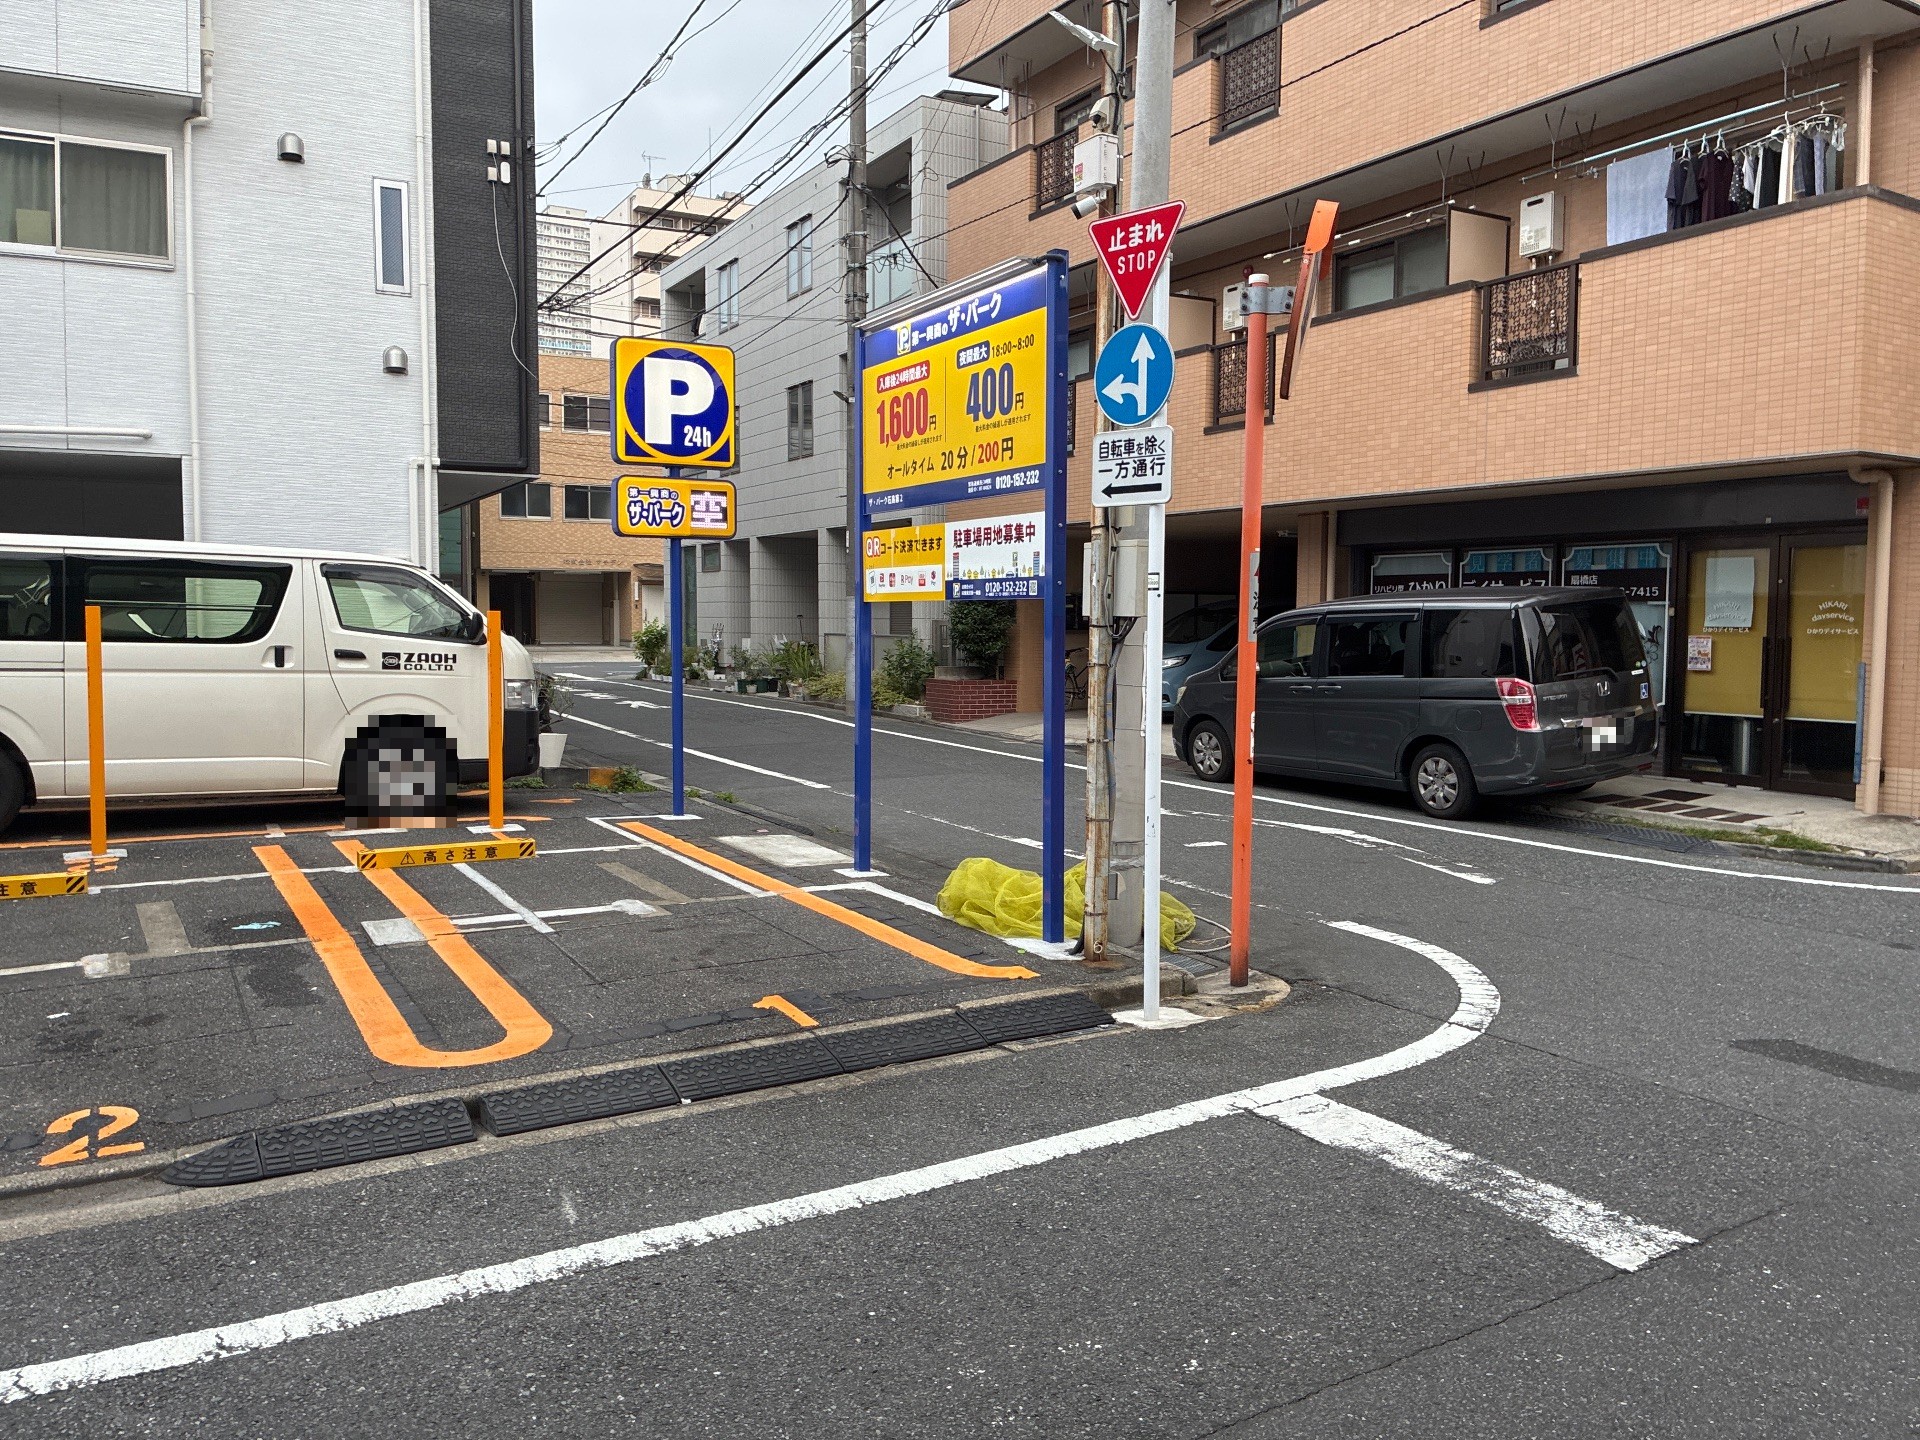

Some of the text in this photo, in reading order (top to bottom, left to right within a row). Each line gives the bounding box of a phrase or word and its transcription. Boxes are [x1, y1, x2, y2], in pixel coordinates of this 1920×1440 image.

[1108, 219, 1165, 252] 止まれ
[1117, 250, 1156, 275] STOP
[959, 345, 988, 366] 夜間最大
[879, 363, 928, 391] 入庫後24時間最大
[643, 356, 715, 445] P
[683, 425, 712, 448] 24h
[1098, 435, 1166, 460] 自転車を除く
[887, 456, 935, 479] オールタイム
[1098, 456, 1166, 480] 一方通行
[995, 469, 1040, 490] 0120-152-232
[628, 487, 678, 500] 第一興商の
[628, 500, 685, 527] ザ・パーク
[690, 491, 729, 530] 空
[952, 521, 1036, 549] 駐車場用地募集中
[866, 536, 943, 558] QRコード決済できます
[985, 580, 1027, 593] 0120-152-232
[1571, 574, 1598, 585] 扇橋店
[1619, 586, 1659, 597] -7415
[1818, 600, 1848, 611] HIKARI
[1806, 627, 1859, 635] ひかりデイサービス
[403, 652, 457, 664] ZAOH
[423, 846, 499, 864] 高さ注意
[38, 1104, 145, 1167] 2
